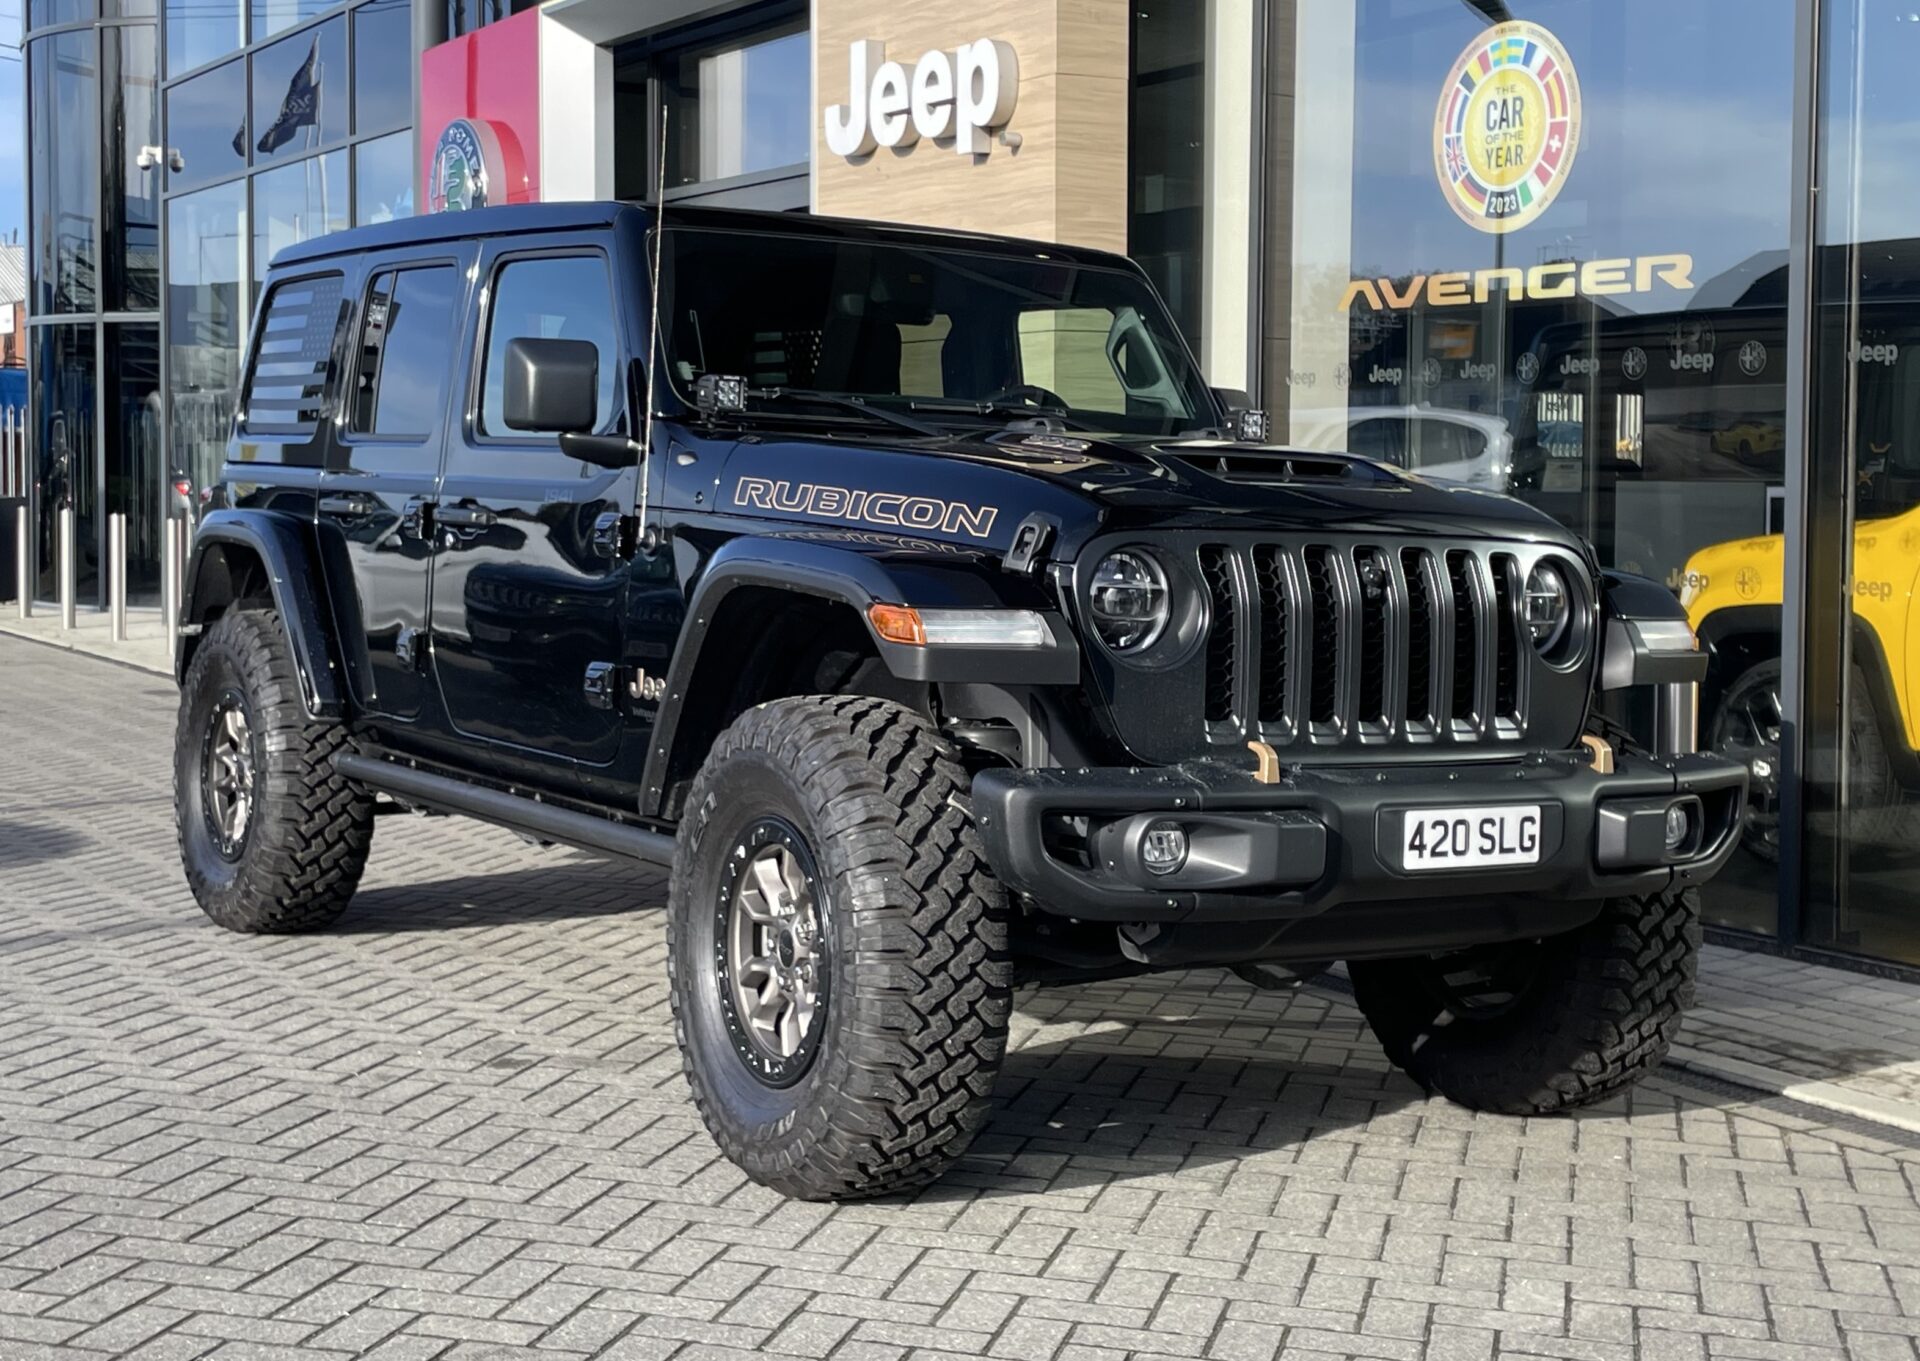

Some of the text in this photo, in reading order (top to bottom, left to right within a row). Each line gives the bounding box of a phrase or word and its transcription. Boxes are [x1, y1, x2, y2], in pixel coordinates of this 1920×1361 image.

[825, 38, 1012, 156] Jeep
[1495, 84, 1517, 95] THE
[1486, 96, 1524, 132] CAR
[1485, 130, 1524, 145] OF THE
[1486, 145, 1524, 170] YEAR
[1489, 194, 1518, 213] 2023
[1337, 253, 1695, 312] AVENGER
[1560, 354, 1600, 377] Jeep
[1670, 350, 1714, 373] Jeep
[1847, 340, 1899, 366] Jeep
[1285, 368, 1316, 388] Jeep
[1368, 364, 1403, 386] Jeep
[1460, 360, 1497, 381] Jeep
[734, 476, 999, 538] RUBICON
[1666, 567, 1710, 593] Jeep
[1842, 574, 1893, 603] Jeep
[629, 667, 667, 702] Jee
[1408, 815, 1537, 859] 420 SLG
